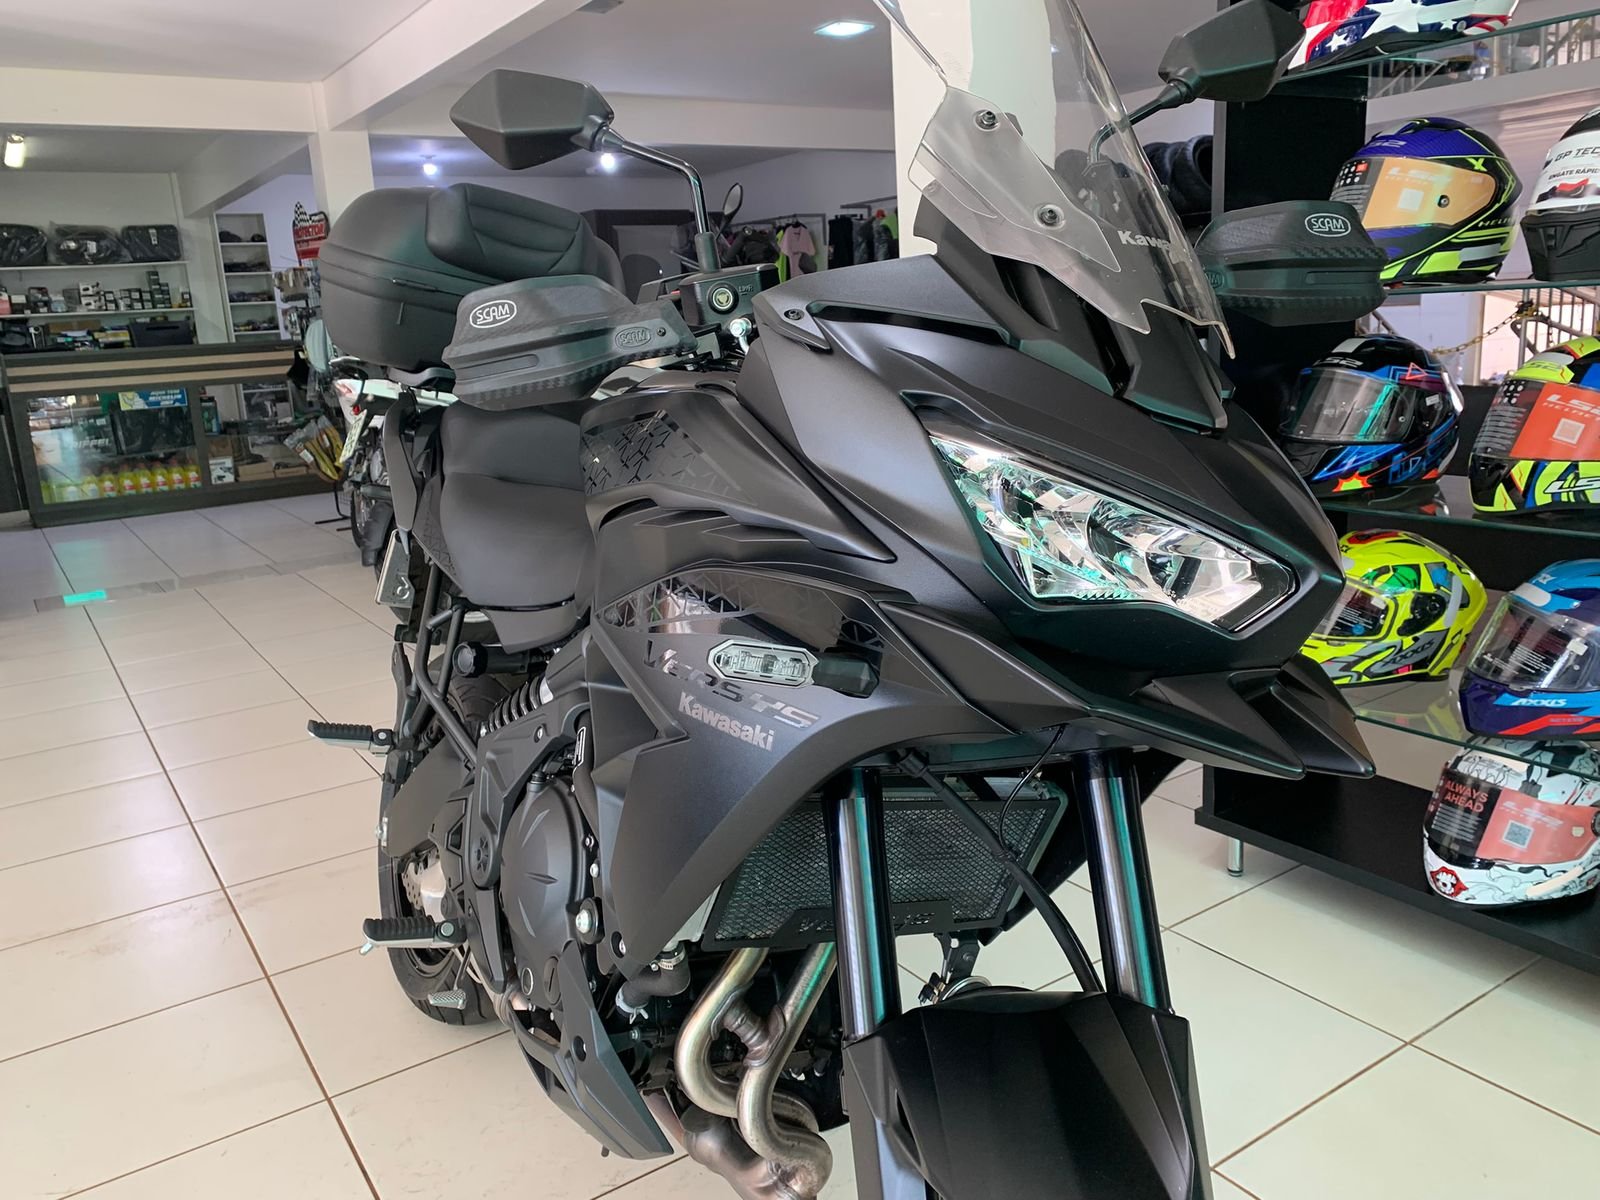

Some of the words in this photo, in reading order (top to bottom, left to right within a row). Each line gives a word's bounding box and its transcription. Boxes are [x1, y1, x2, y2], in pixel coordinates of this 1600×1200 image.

[1554, 150, 1573, 162] GP
[1309, 216, 1347, 232] SCAM
[474, 303, 511, 325] SCAM
[1511, 698, 1568, 708] AXXIS
[678, 691, 775, 752] Kawasaki
[1445, 780, 1489, 803] ALWAYS
[1444, 792, 1484, 814] AHEAD
